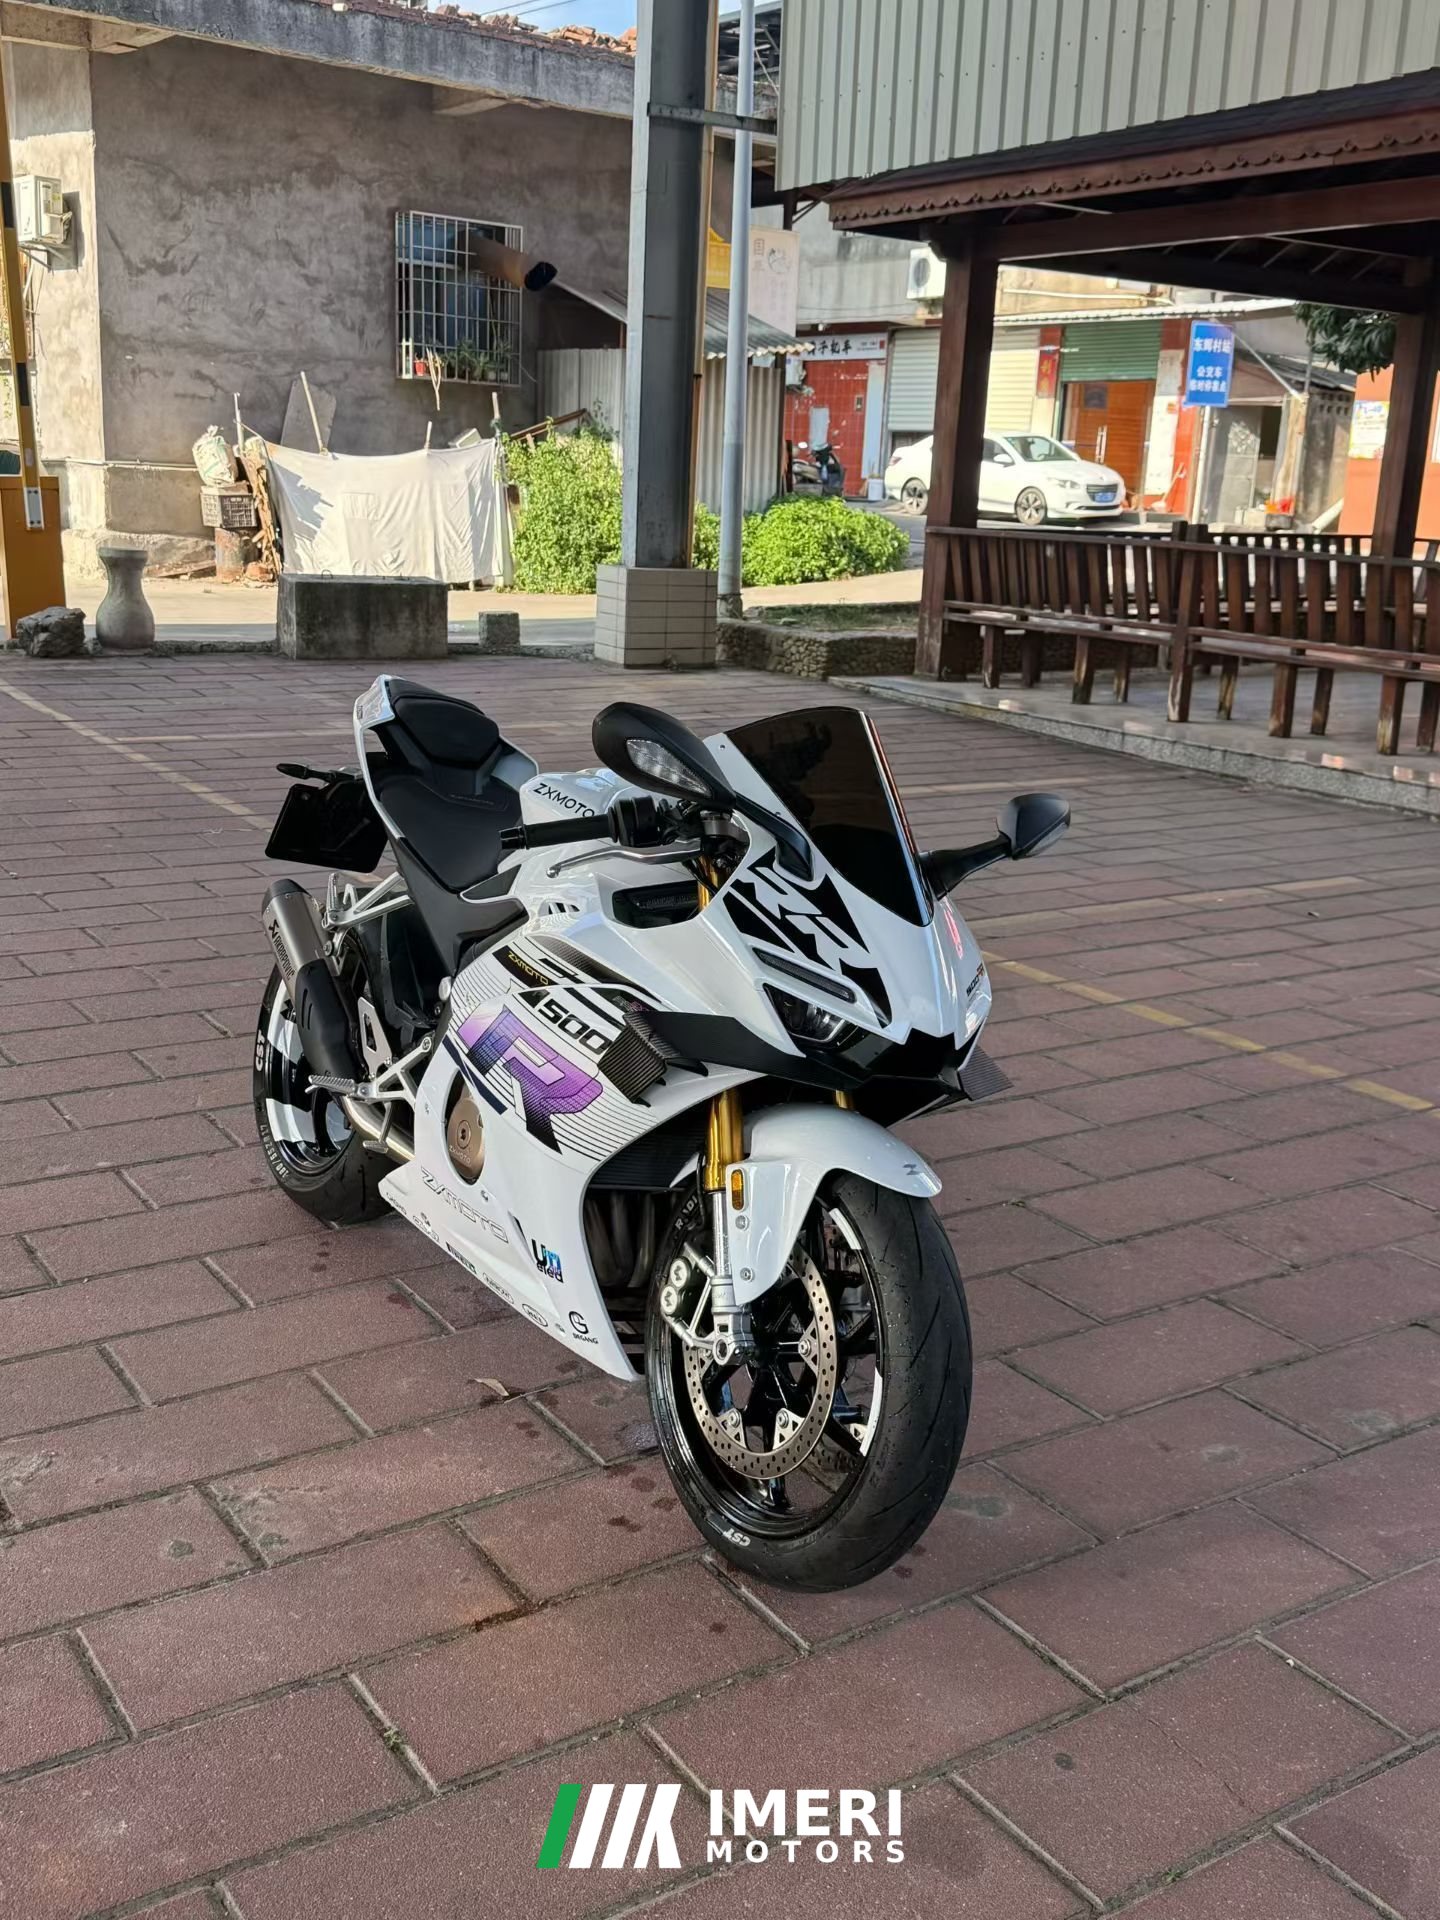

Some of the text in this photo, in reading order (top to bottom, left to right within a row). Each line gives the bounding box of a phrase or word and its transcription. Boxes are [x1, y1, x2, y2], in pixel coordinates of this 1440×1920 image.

[533, 782, 595, 818] ZXMOTO
[507, 951, 550, 987] ZXMOTO
[255, 1029, 266, 1072] CST
[722, 1528, 751, 1547] CST
